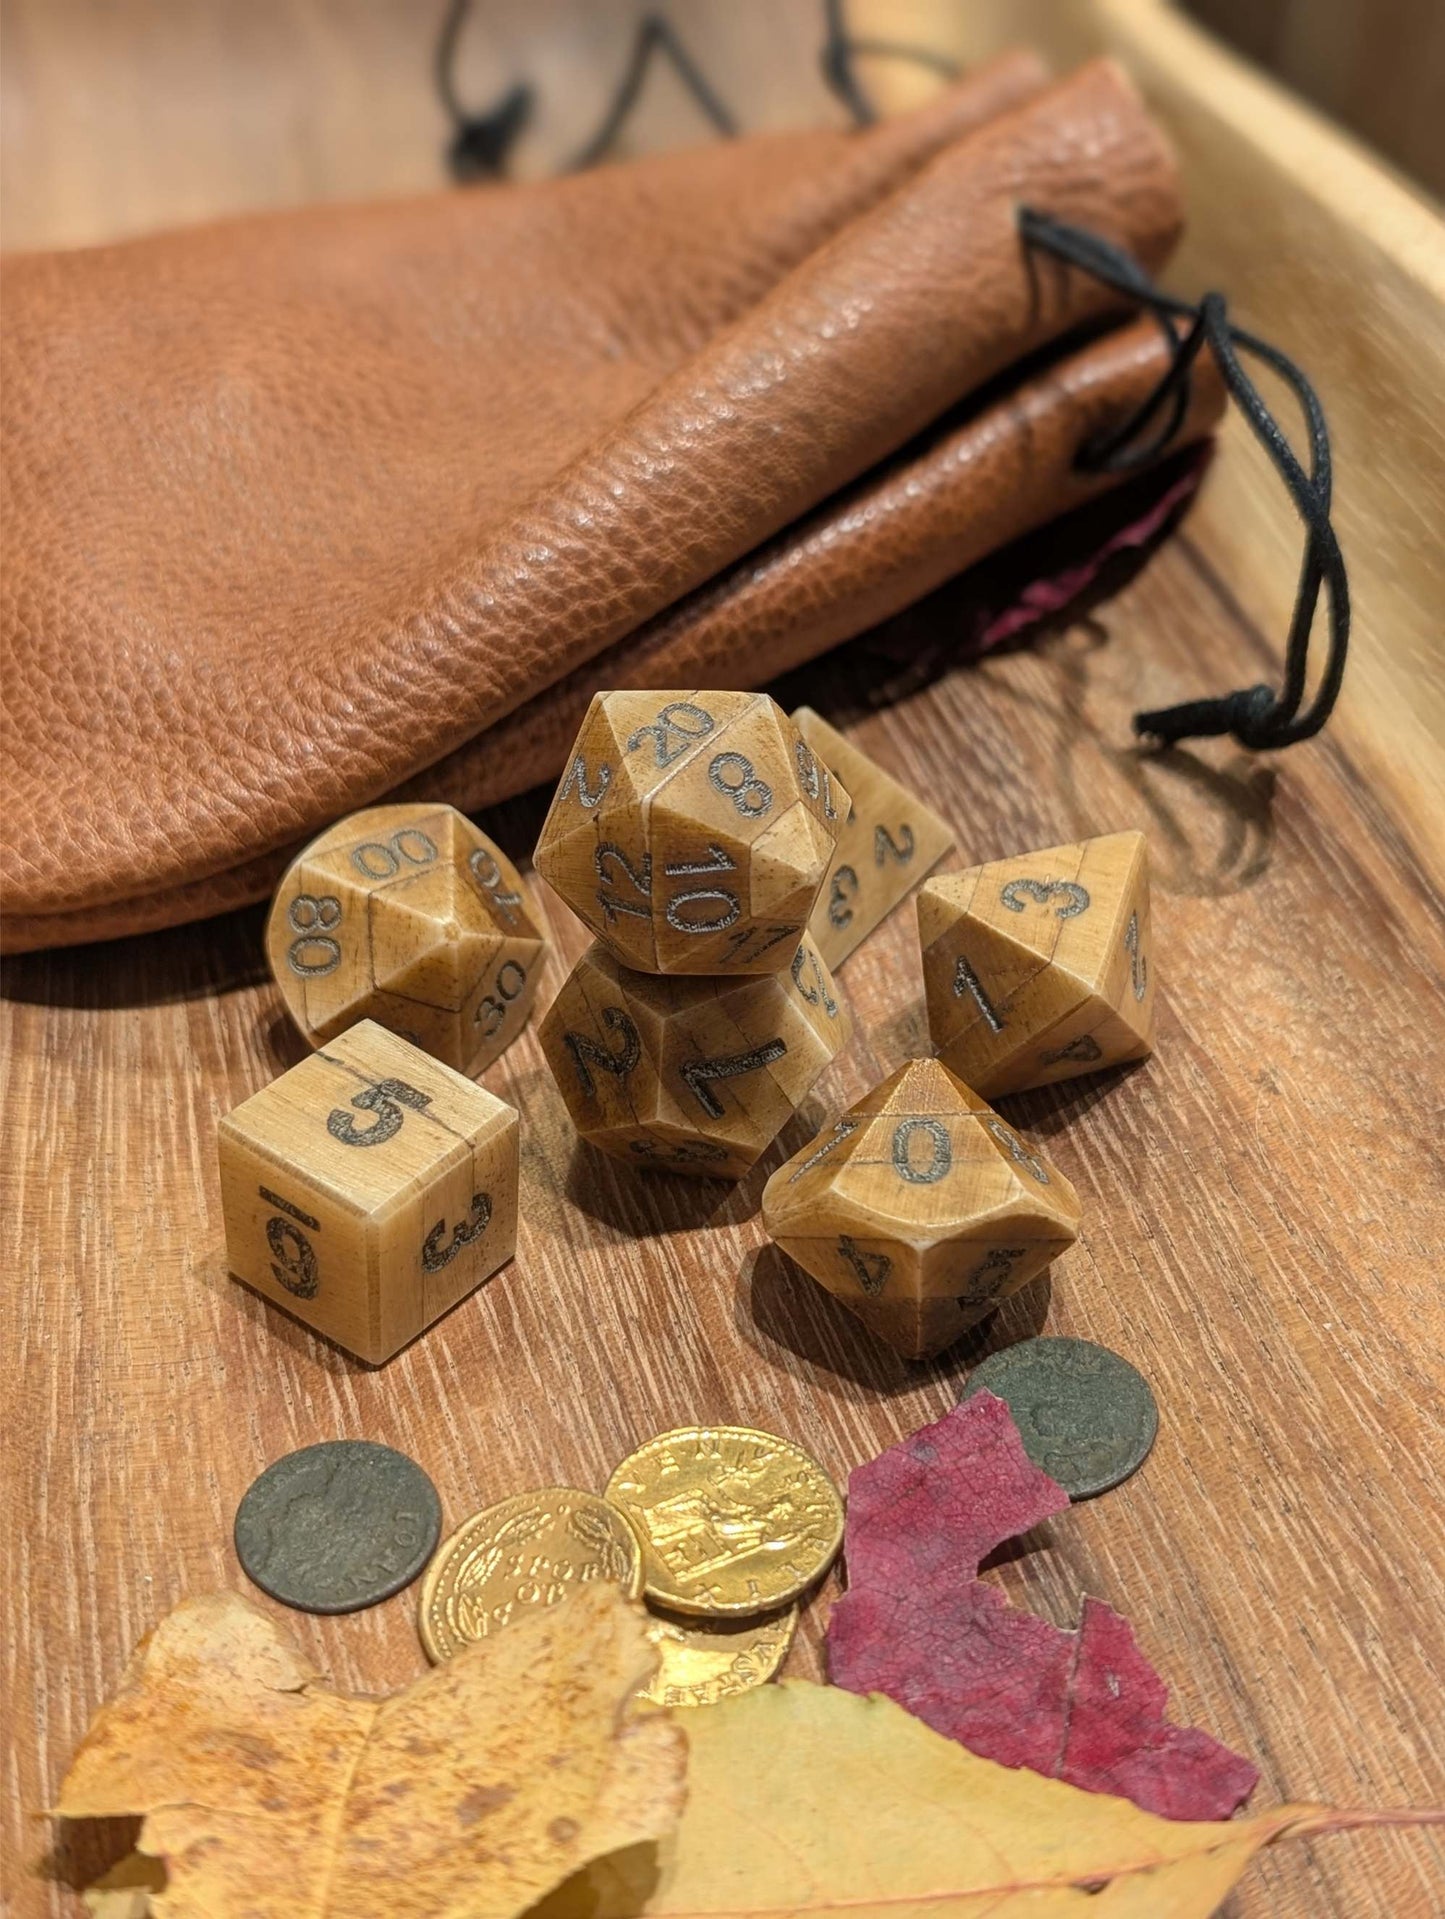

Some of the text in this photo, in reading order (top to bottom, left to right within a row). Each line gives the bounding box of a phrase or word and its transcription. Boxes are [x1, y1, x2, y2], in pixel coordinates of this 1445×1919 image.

[627, 702, 714, 769] 20
[560, 755, 611, 809] 2
[709, 752, 773, 819] 8
[352, 829, 438, 881] 00
[874, 824, 915, 868] 2
[595, 841, 653, 923] 12
[665, 843, 741, 934] 10
[828, 864, 858, 931] 3
[1001, 878, 1091, 920] 3
[287, 893, 342, 978] 80
[474, 960, 527, 1037] 30
[953, 954, 1004, 1033] 1
[564, 1007, 641, 1098] 2
[680, 1037, 788, 1120] 7
[327, 1077, 433, 1147] 5
[892, 1117, 952, 1184] 0
[422, 1192, 493, 1274] 3
[838, 1234, 893, 1298] 4
